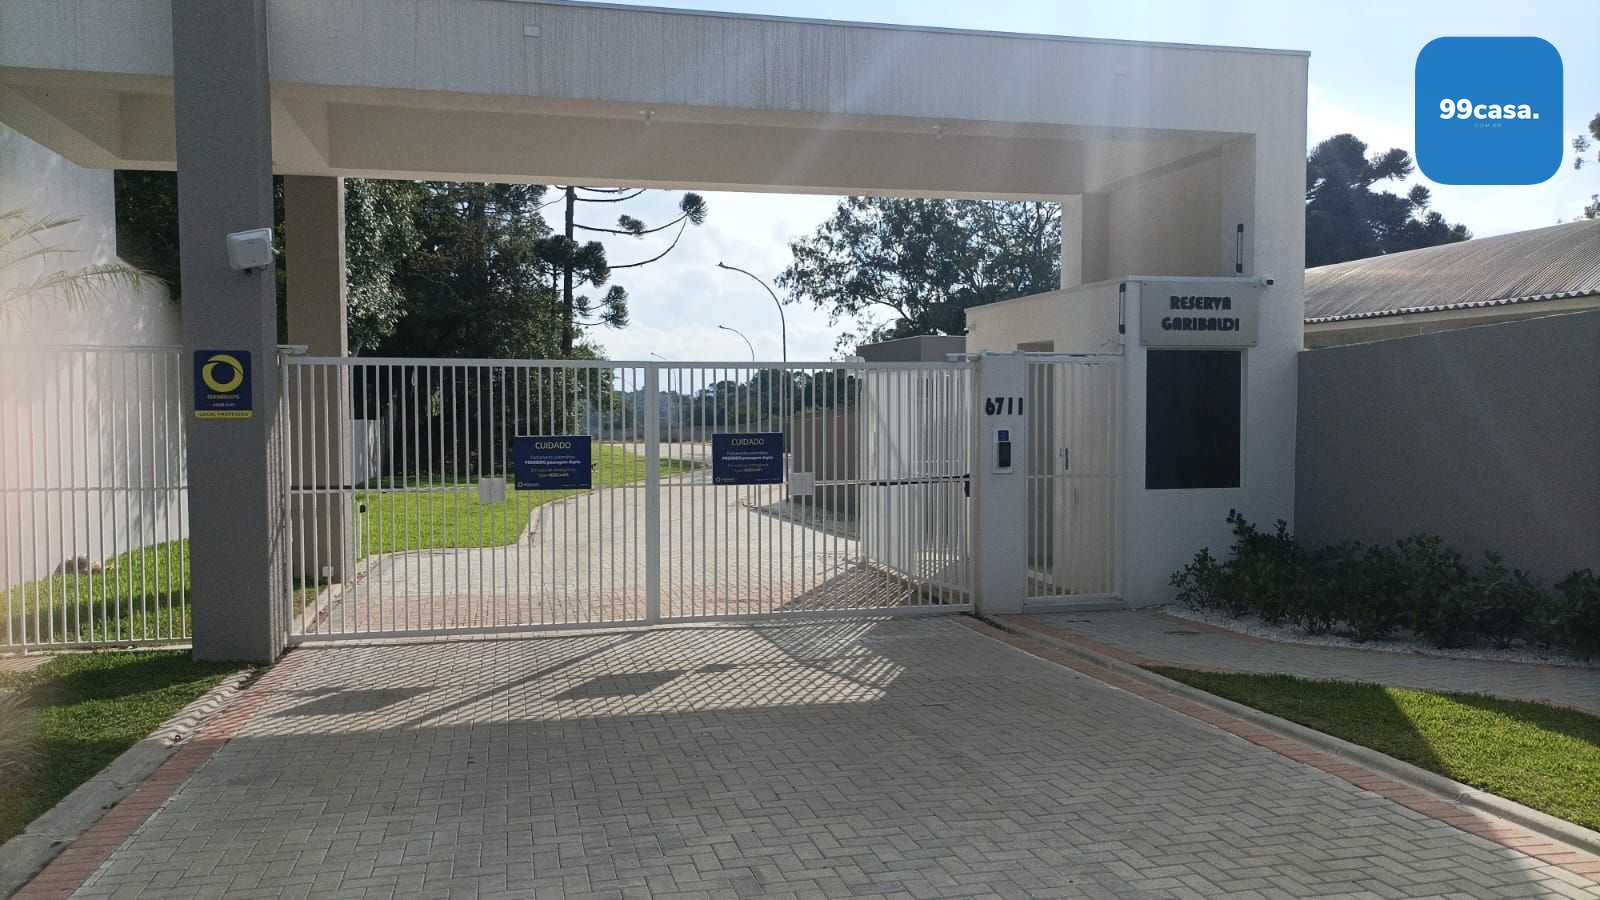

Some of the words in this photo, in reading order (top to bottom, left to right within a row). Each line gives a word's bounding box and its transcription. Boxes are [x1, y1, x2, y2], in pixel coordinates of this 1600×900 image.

[1170, 296, 1232, 310] RESERVA
[1161, 317, 1240, 331] GARIBALDI
[985, 397, 1024, 415] 6711
[535, 441, 572, 449] CUIDADO
[731, 438, 765, 446] CUIDADO
